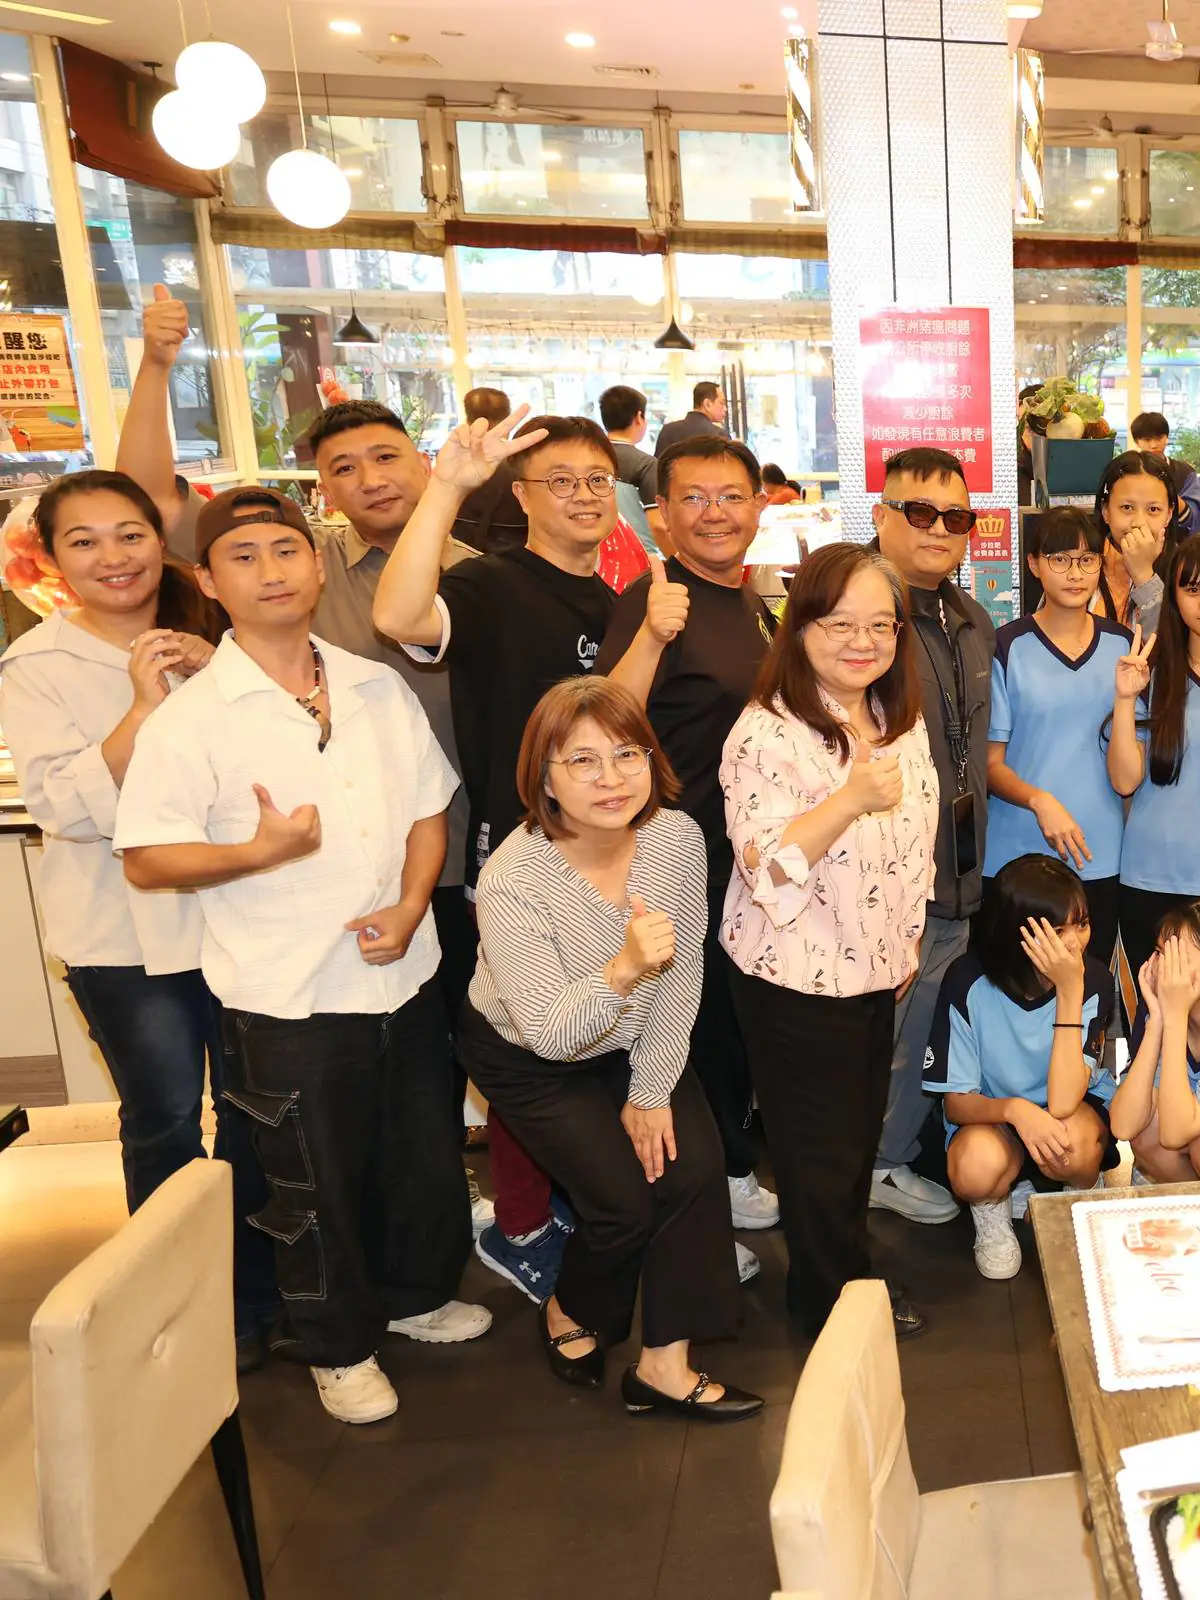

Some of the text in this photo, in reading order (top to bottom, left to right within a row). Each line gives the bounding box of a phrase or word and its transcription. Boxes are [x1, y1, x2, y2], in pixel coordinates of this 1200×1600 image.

[880, 319, 971, 335] 因非洲豬瘟問題
[0, 331, 48, 351] 醒您
[871, 426, 985, 442] 如發現有任意浪費者
